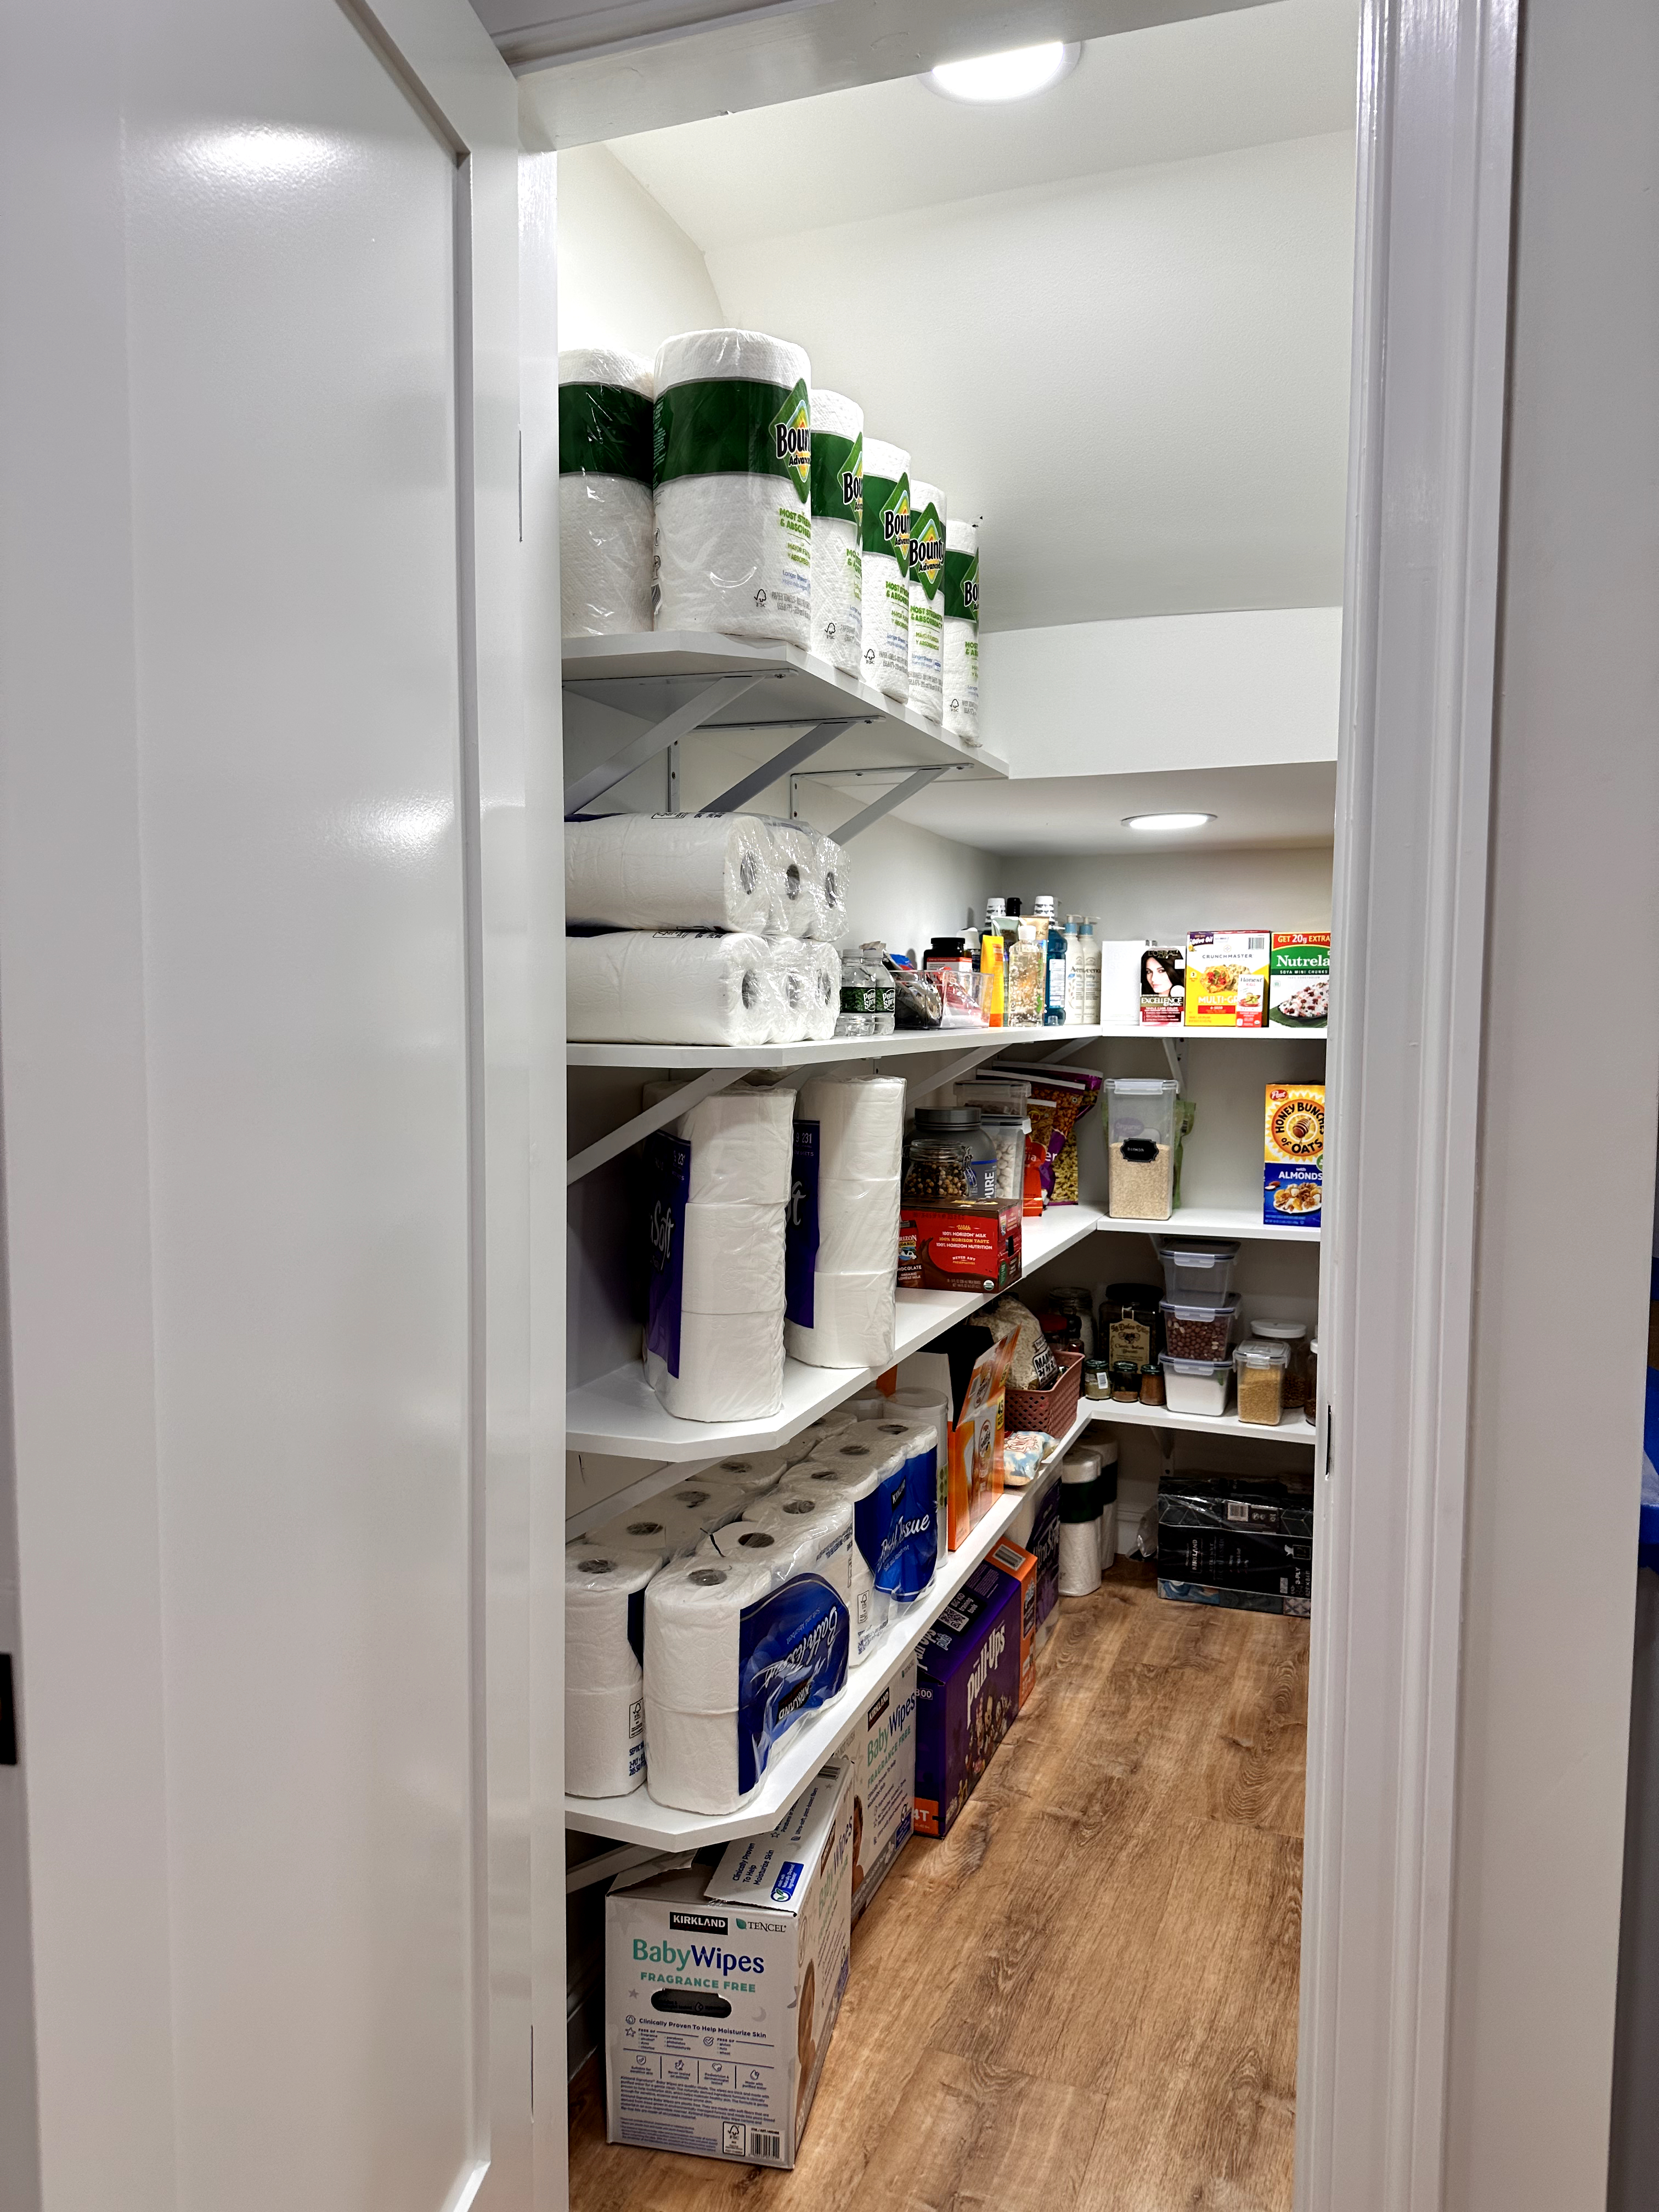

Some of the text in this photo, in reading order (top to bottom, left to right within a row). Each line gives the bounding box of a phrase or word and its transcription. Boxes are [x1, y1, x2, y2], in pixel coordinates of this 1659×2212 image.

[779, 507, 797, 522] MOST
[910, 537, 945, 567] Bounty
[918, 562, 941, 572] Advanced
[910, 606, 926, 614] MOST
[1292, 934, 1307, 944] 20g
[1276, 955, 1330, 967] Nutrela
[1198, 996, 1238, 1004] MULTI-GR
[1272, 1090, 1286, 1099] Post
[1275, 1103, 1295, 1133] HONEY
[802, 1133, 812, 1144] 231
[1282, 1137, 1323, 1154] of OATS
[1278, 1171, 1323, 1181] ALMONDS
[806, 1606, 838, 1666] Bath
[779, 1685, 810, 1720] KIRKLAND
[867, 1741, 898, 1788] FRAGRANCE
[899, 1725, 911, 1747] FREE
[732, 1843, 755, 1881] Clinically Proven
[753, 1849, 774, 1885] Moisturize Skin
[746, 1864, 757, 1876] Help
[673, 1915, 726, 1928] KIRKLAND
[640, 1972, 756, 1993] FRAGRANCE FREE
[639, 2018, 667, 2027] Clinically
[669, 2021, 691, 2029] Proven
[718, 2027, 751, 2037] Moisturize
